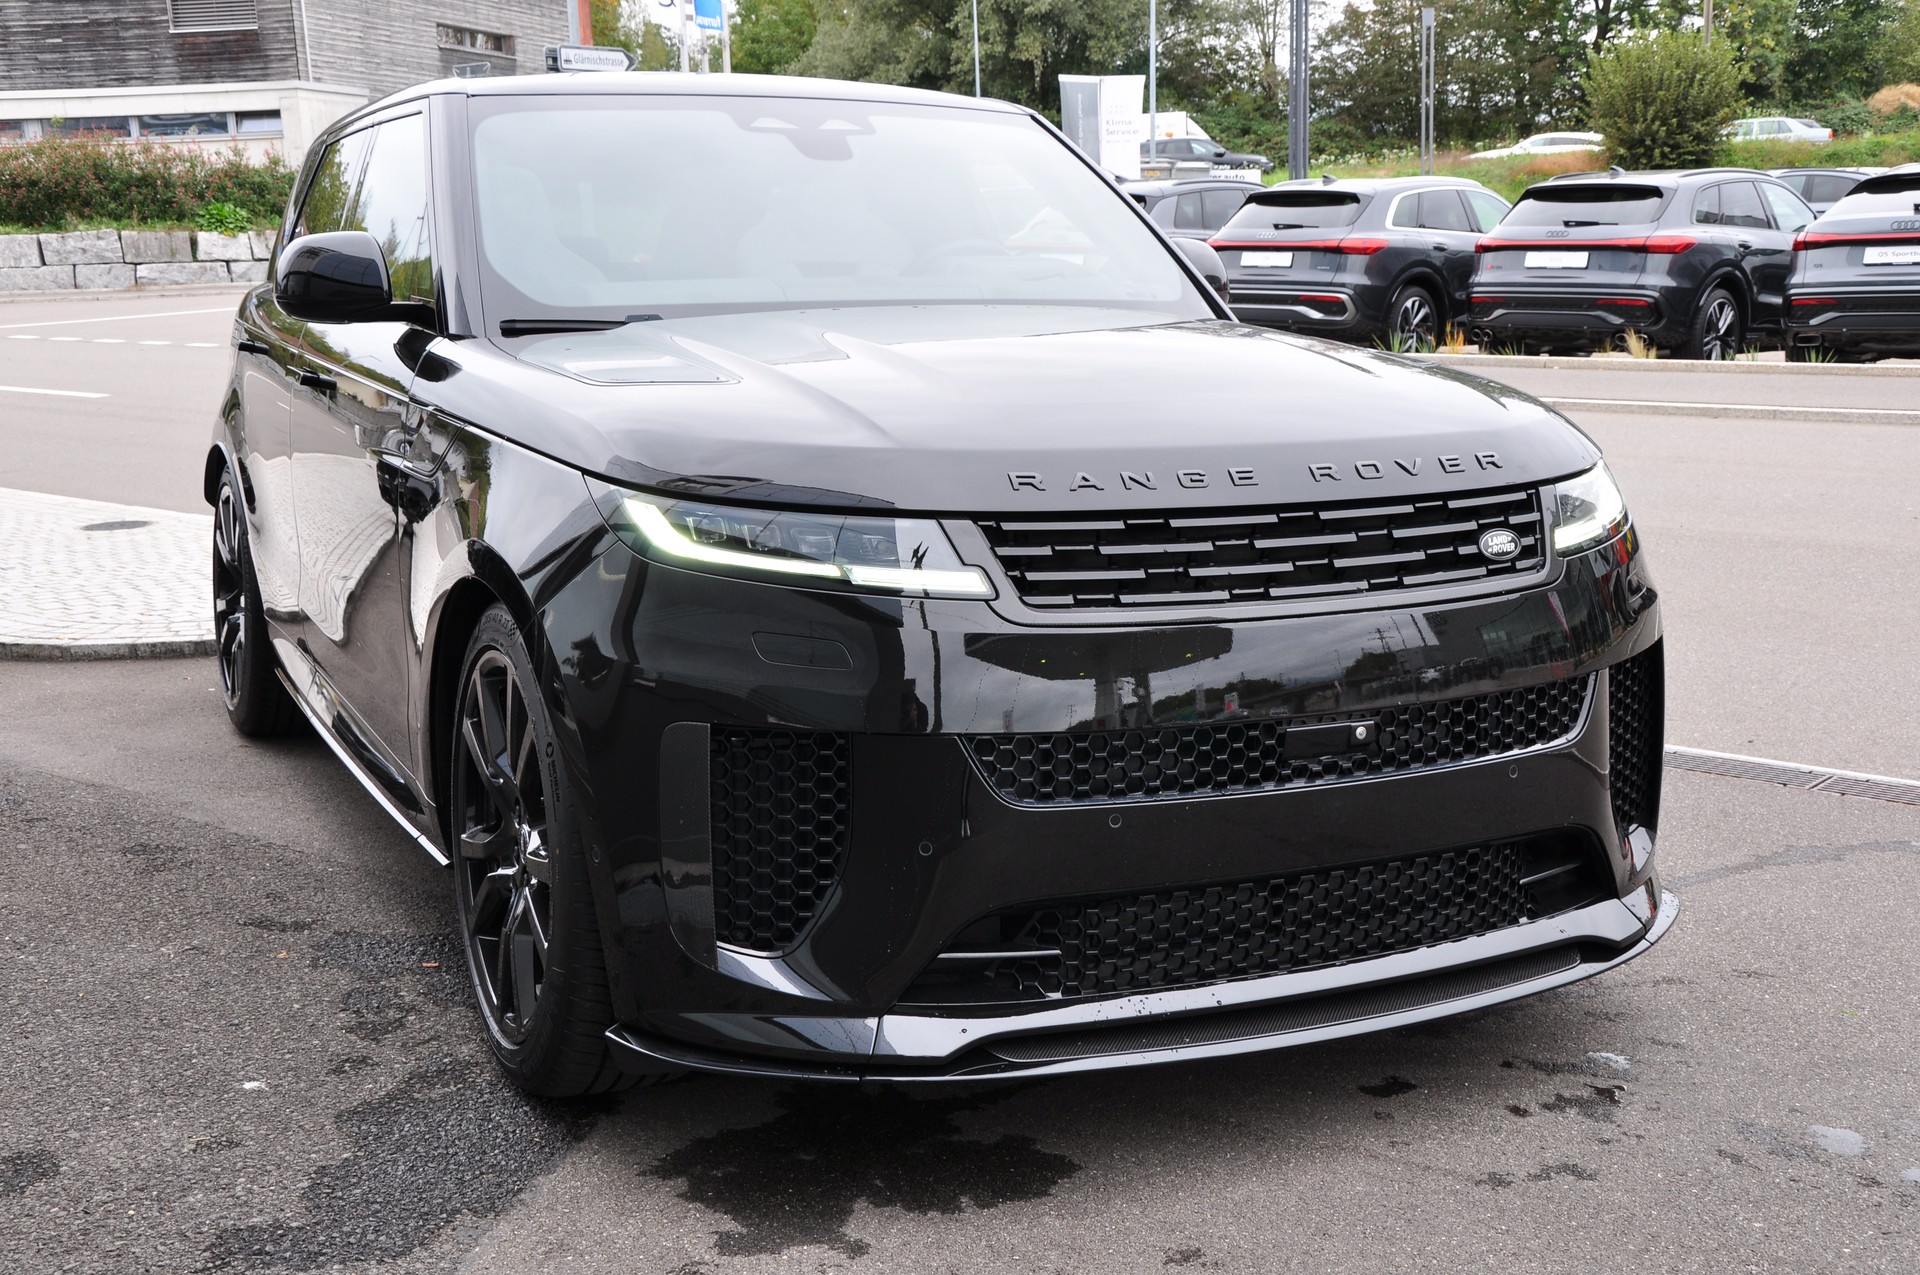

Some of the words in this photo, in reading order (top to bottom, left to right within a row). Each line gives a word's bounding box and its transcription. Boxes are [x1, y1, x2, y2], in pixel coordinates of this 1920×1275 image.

[573, 53, 624, 68] Glärnischstrasse
[1105, 128, 1139, 136] Service
[1007, 467, 1259, 492] RANGE
[1308, 451, 1504, 483] ROVER
[1488, 535, 1508, 546] LAND
[1492, 542, 1516, 554] ROVER
[551, 760, 561, 803] MICHELIN
